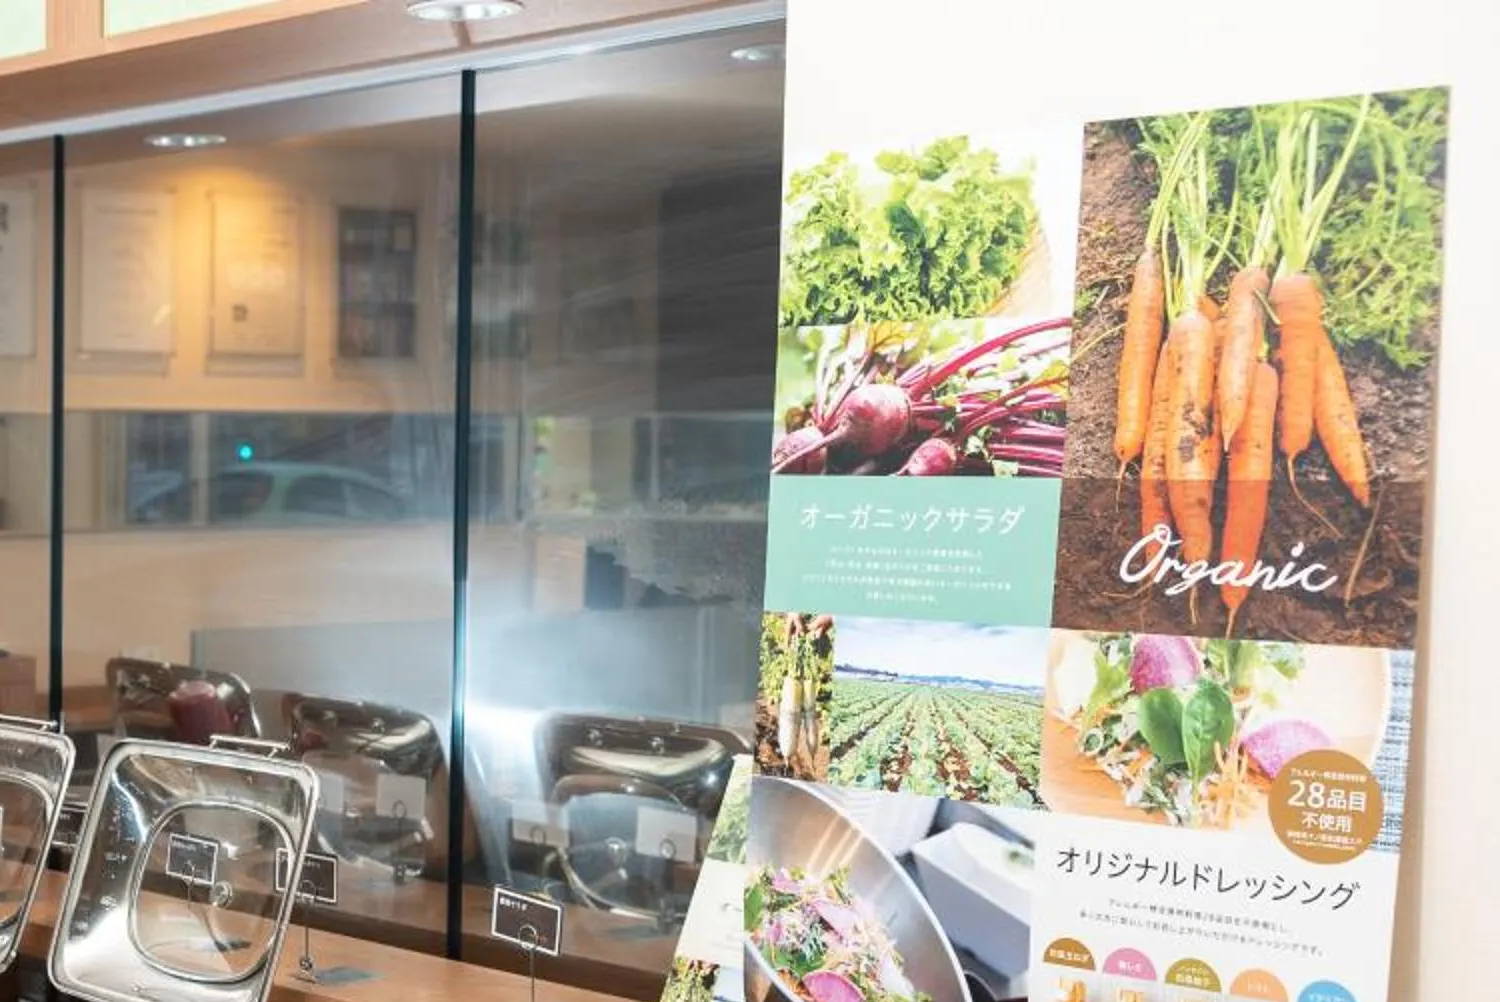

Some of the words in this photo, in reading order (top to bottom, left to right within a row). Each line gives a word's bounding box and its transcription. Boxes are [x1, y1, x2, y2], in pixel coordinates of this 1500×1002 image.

[801, 503, 1026, 534] オーガニックサラダ
[1119, 523, 1338, 597] Organic
[1287, 780, 1367, 813] 28品目
[1301, 811, 1353, 832] 不使用
[1056, 846, 1361, 911] オリジナルドレッシング
